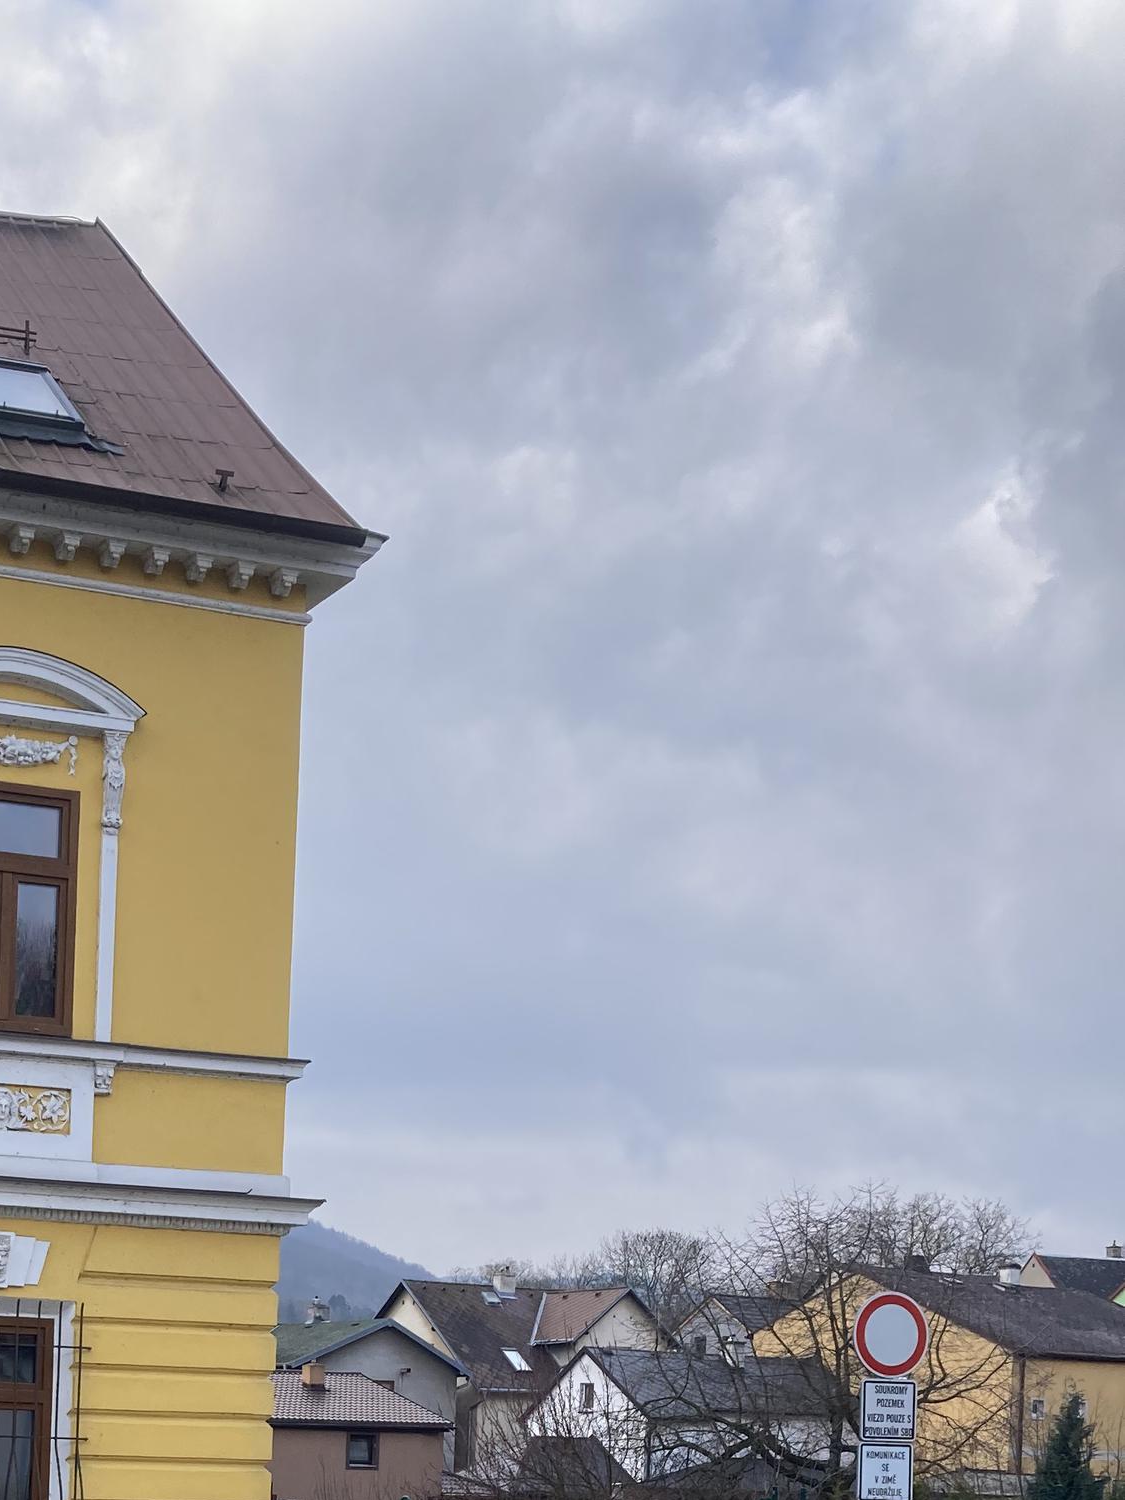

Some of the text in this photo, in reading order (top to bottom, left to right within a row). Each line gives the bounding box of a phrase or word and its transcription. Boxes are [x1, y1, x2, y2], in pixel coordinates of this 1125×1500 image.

[876, 1398, 905, 1408] POZEMEK
[886, 1413, 906, 1423] POUZE
[906, 1415, 912, 1424] S
[866, 1450, 906, 1460] KOMUNIKACE
[881, 1463, 890, 1472] SE
[874, 1473, 896, 1485] V ZIMĚ
[867, 1486, 902, 1497] NEUDRŽUJE
